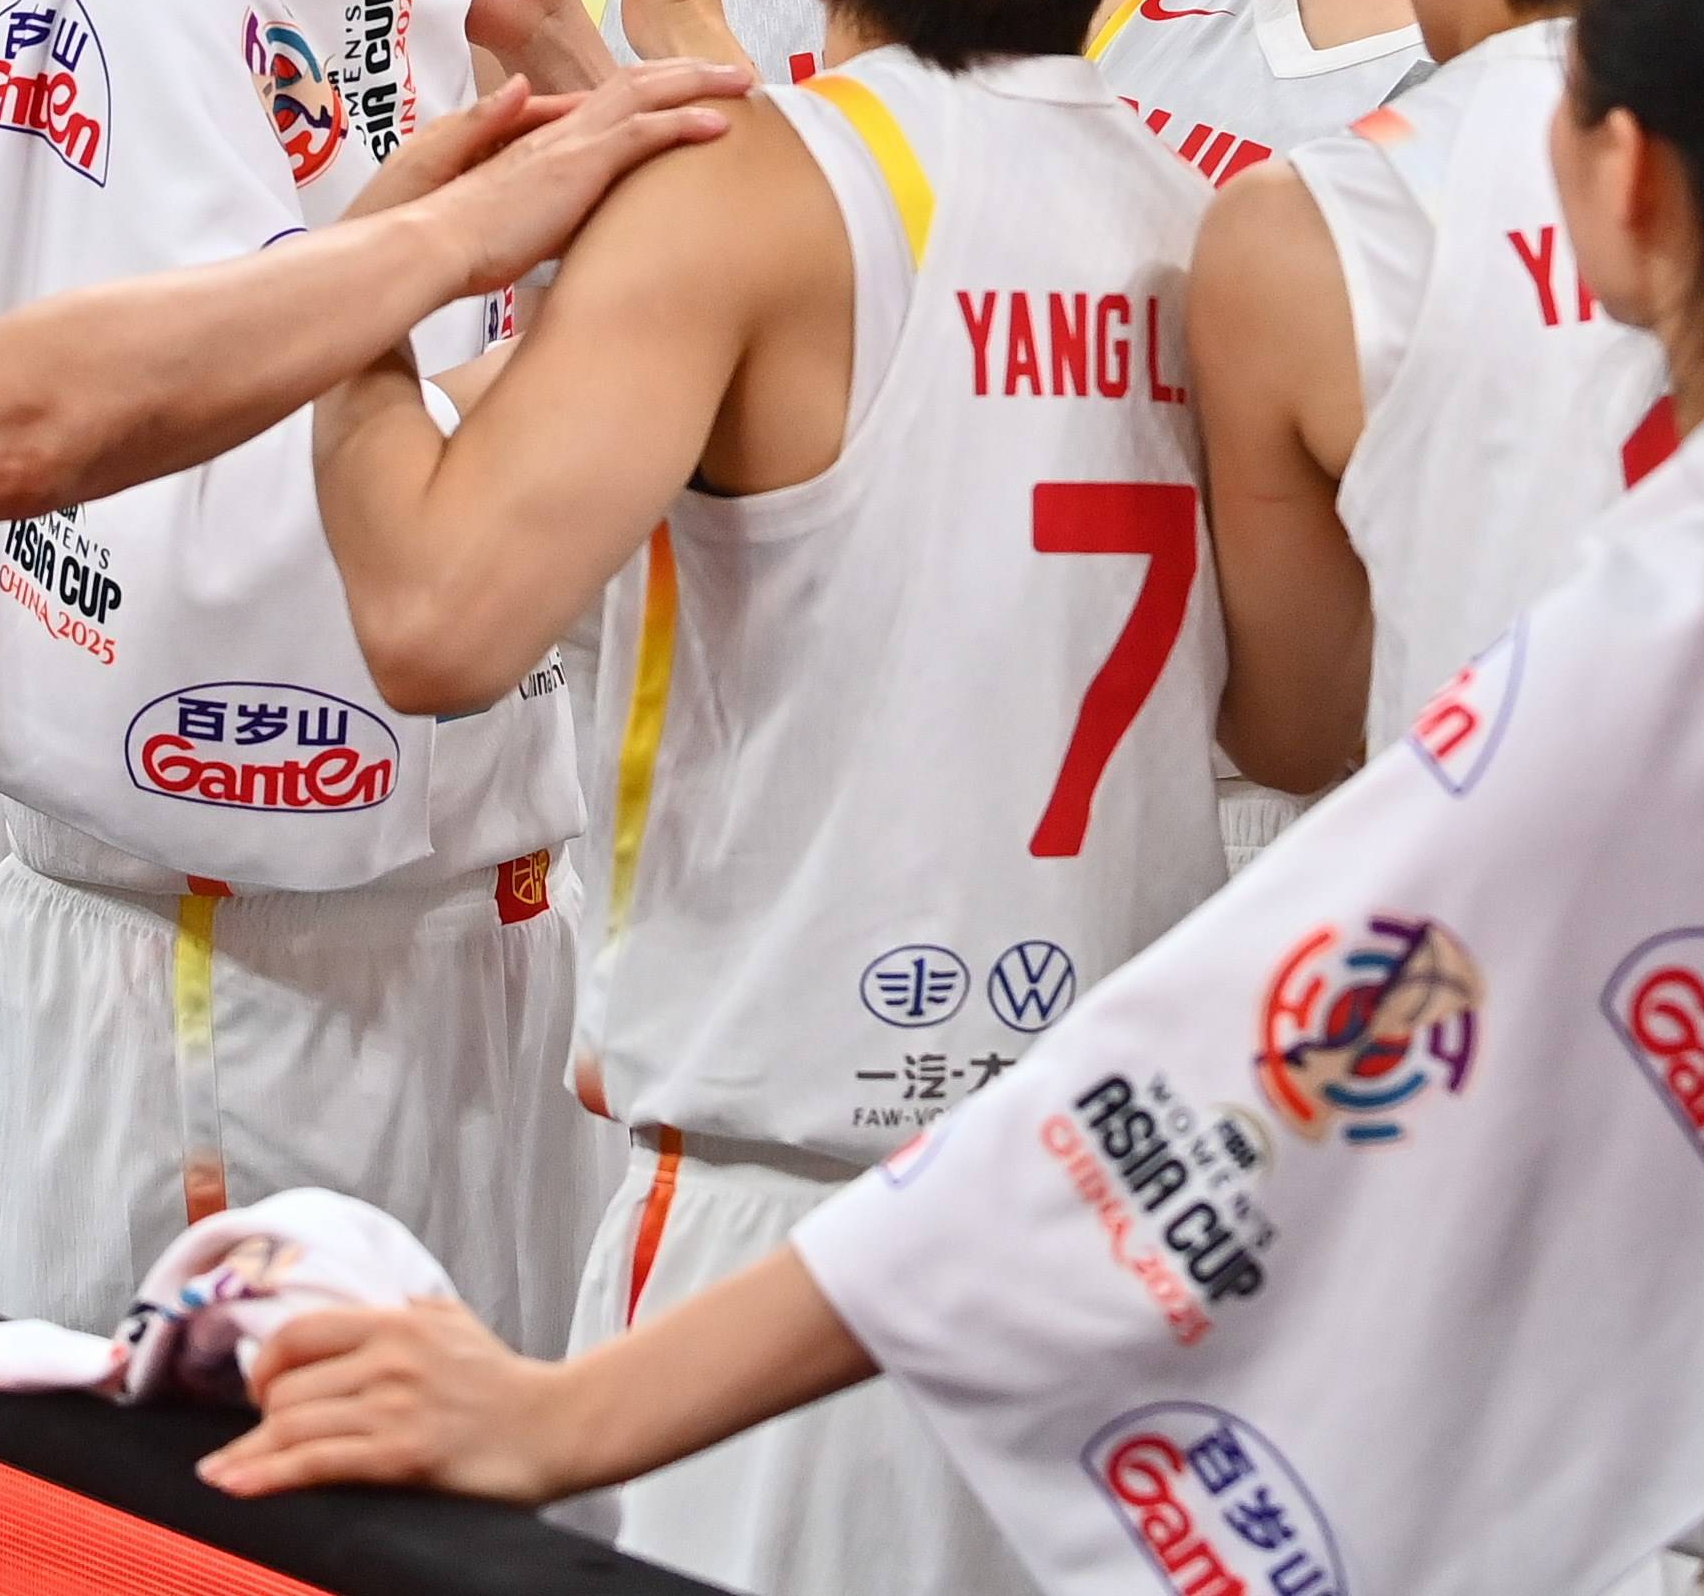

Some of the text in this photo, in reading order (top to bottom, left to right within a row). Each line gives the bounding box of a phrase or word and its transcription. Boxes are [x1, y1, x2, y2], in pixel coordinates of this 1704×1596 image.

[956, 290, 1187, 404] YANG L.
[4, 518, 123, 625] ASIA CUP
[56, 610, 117, 666] 2025
[1029, 480, 1199, 858] 7
[141, 732, 393, 807] Ganten
[176, 696, 350, 748] 百岁山
[1075, 1075, 1265, 1302] ASIA CUP
